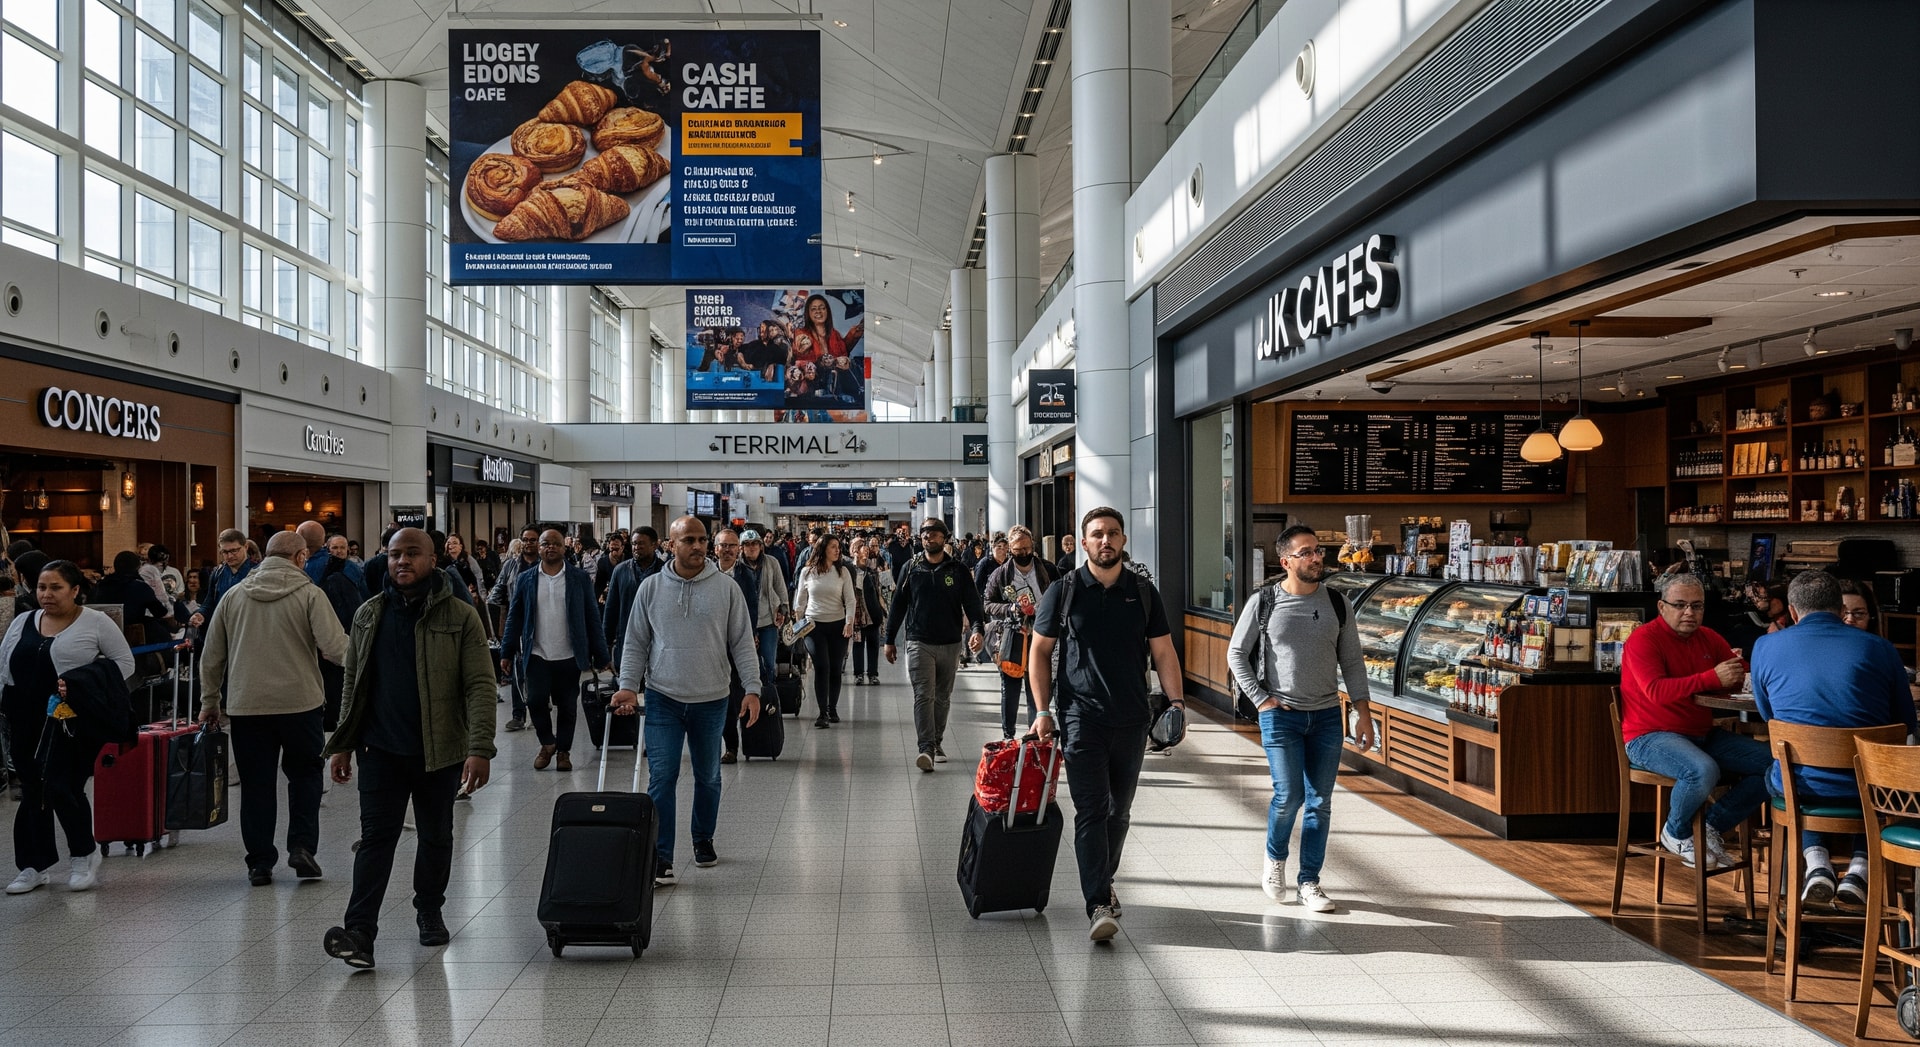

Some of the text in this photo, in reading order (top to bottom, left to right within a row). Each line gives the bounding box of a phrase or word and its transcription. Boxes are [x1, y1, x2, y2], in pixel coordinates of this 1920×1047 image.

[463, 42, 540, 62] LIOGEY
[463, 63, 541, 84] EDONS
[682, 62, 757, 86] CASH
[682, 86, 766, 109] CAFEE
[1296, 233, 1384, 341] CAFES
[42, 386, 161, 442] CONCERS
[714, 434, 860, 455] TERRIMAL 4
